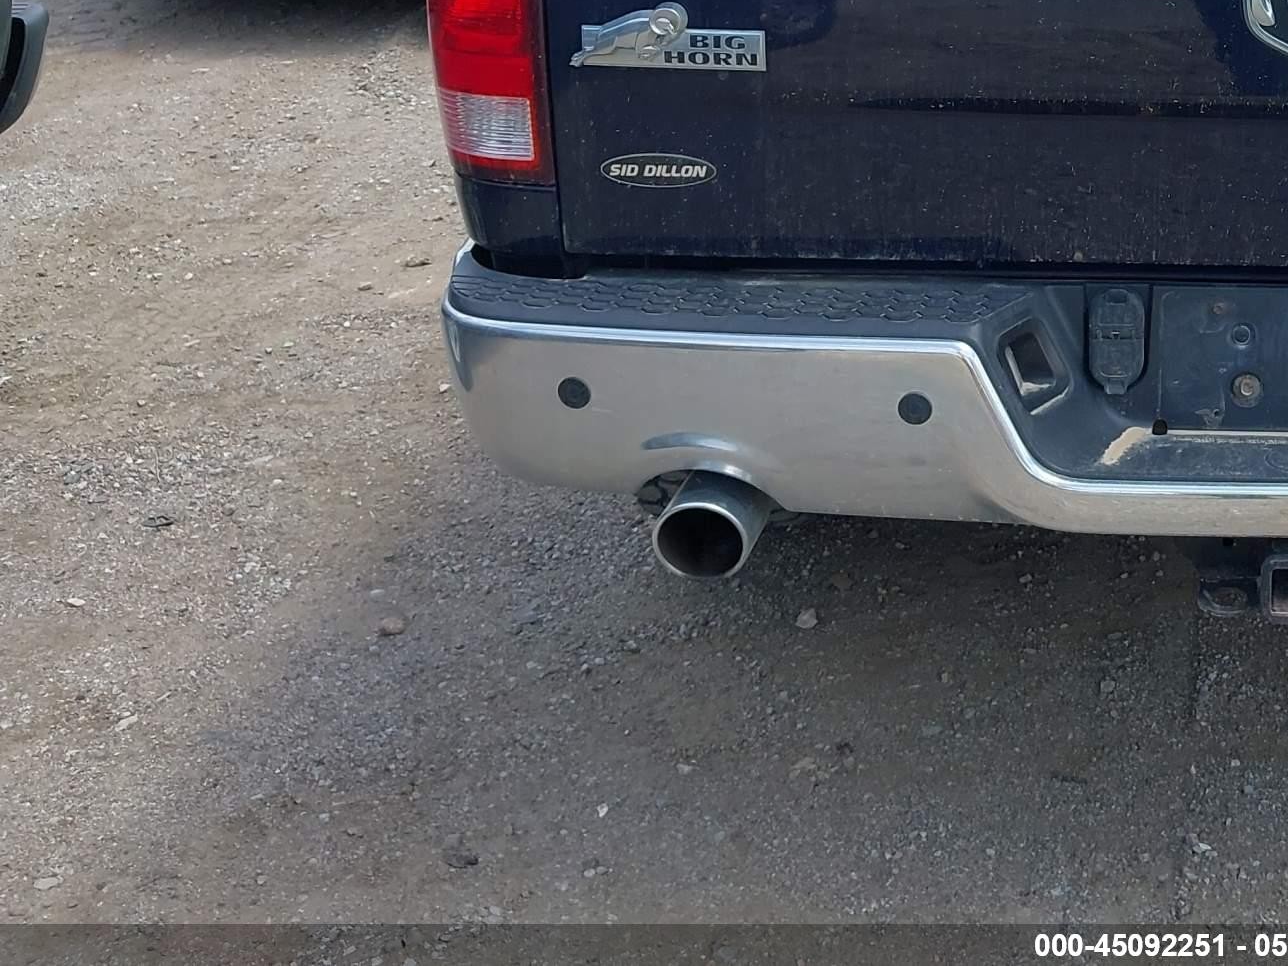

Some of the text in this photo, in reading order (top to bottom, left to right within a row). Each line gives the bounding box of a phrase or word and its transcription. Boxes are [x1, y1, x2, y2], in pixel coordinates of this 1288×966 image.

[690, 35, 746, 50] BIG
[664, 50, 758, 67] HORN
[609, 164, 708, 178] SID DILLON
